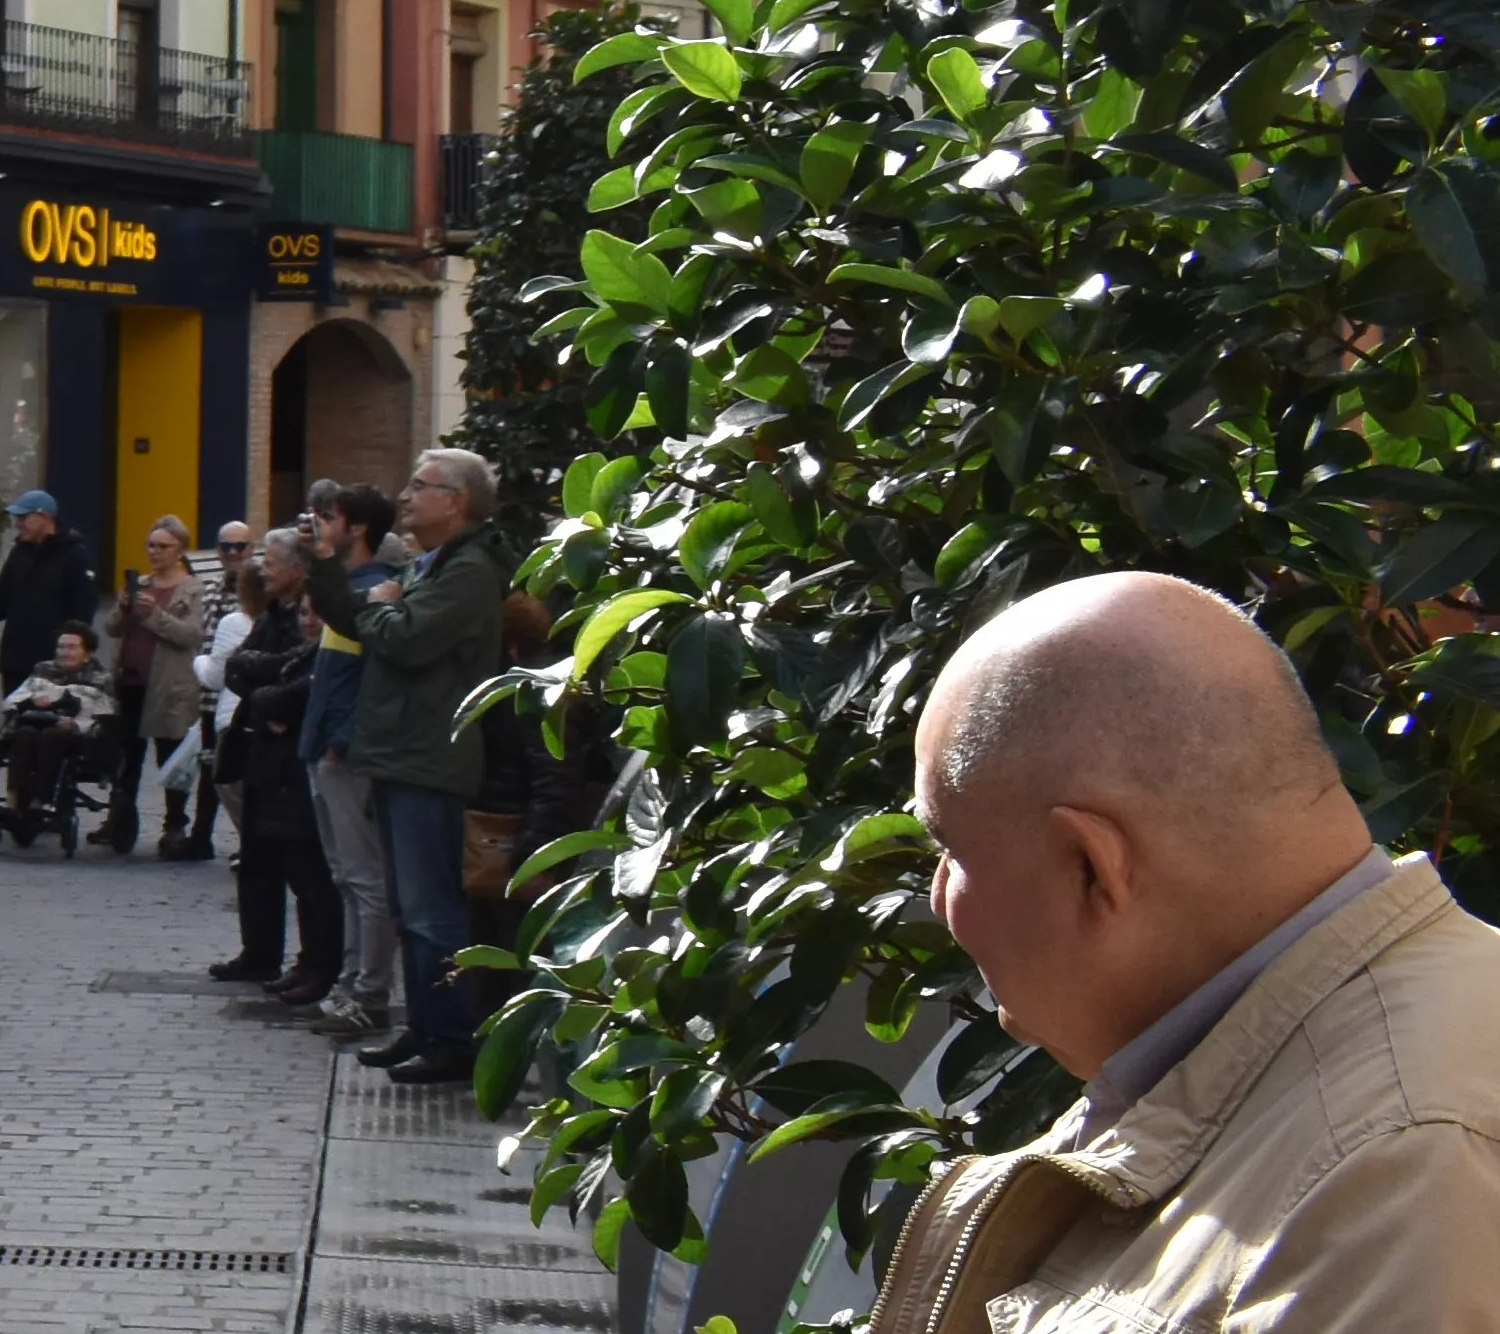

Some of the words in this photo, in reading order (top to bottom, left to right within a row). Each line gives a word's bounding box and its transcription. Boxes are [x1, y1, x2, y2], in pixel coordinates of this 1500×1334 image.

[23, 199, 96, 267] OVS
[113, 221, 157, 260] kids
[268, 234, 320, 258] OVS
[277, 270, 309, 284] kids
